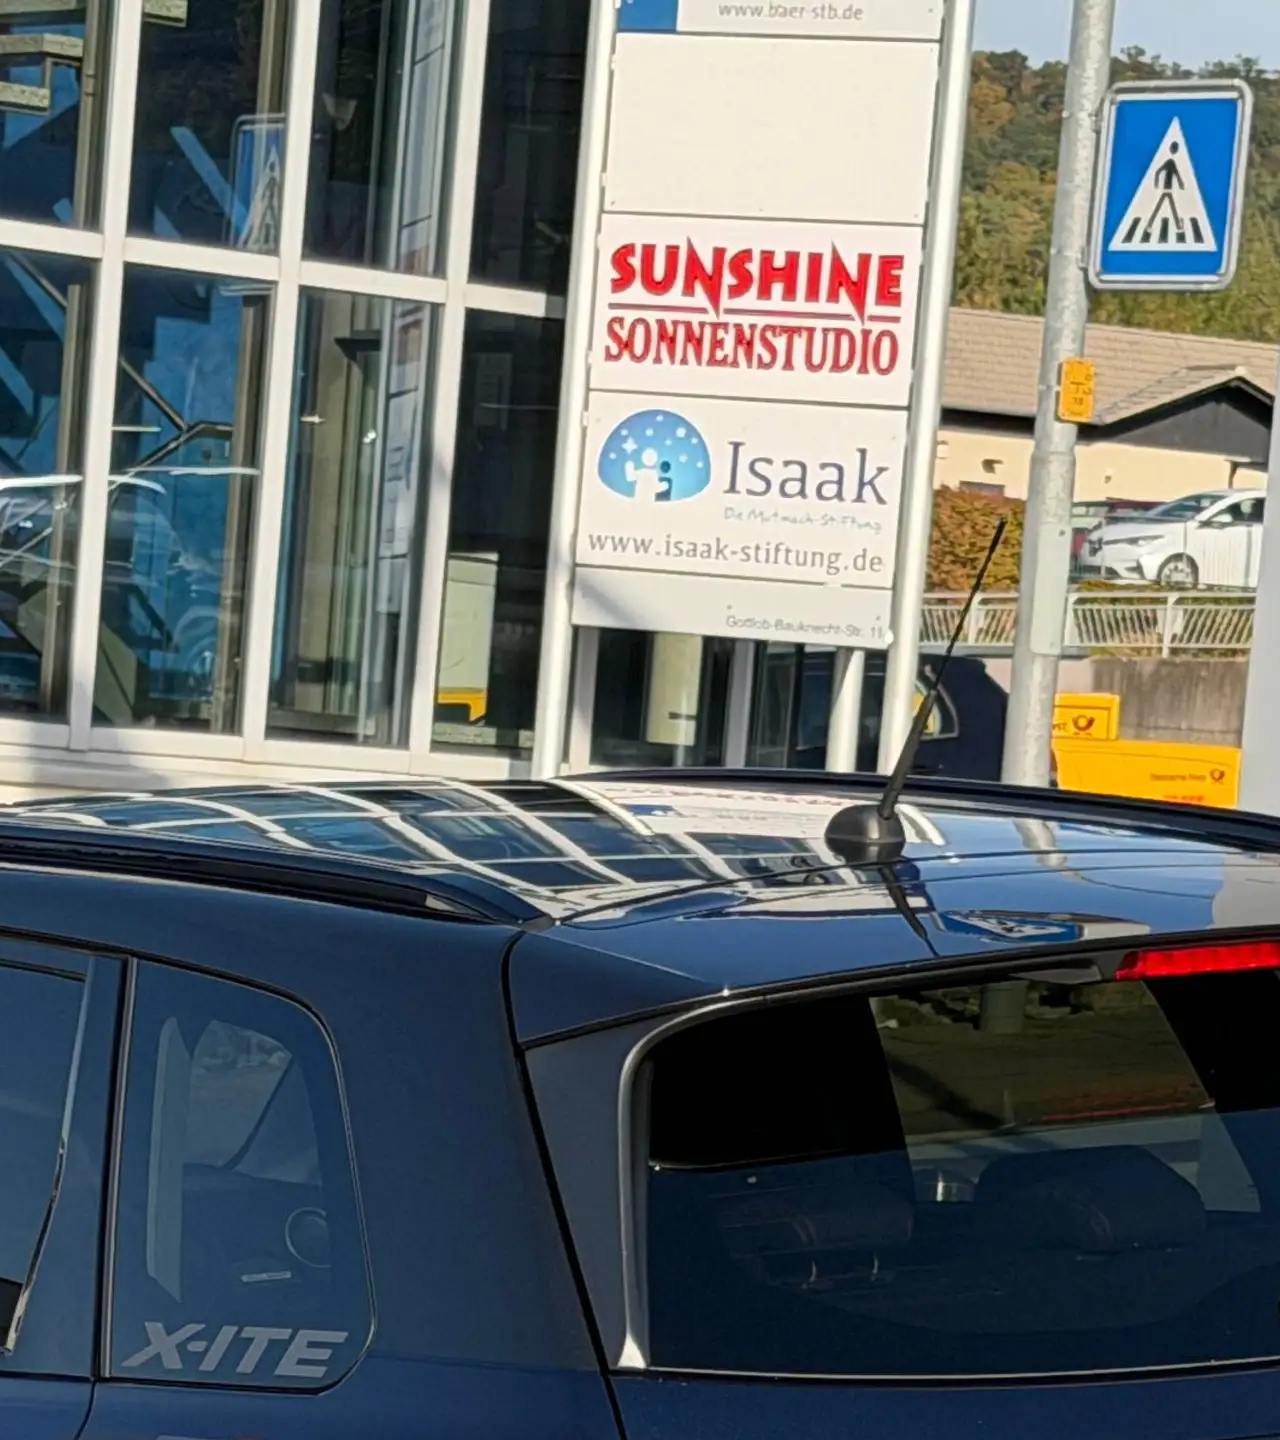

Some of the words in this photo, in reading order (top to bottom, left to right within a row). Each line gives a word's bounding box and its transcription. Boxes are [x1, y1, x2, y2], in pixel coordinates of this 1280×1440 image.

[609, 236, 905, 326] SUNSHINE
[604, 316, 899, 376] SONNENSTUDIO
[723, 440, 889, 505] Isaak
[588, 533, 883, 576] www.isaak-stiftung.de
[121, 1321, 348, 1378] X-ITE
